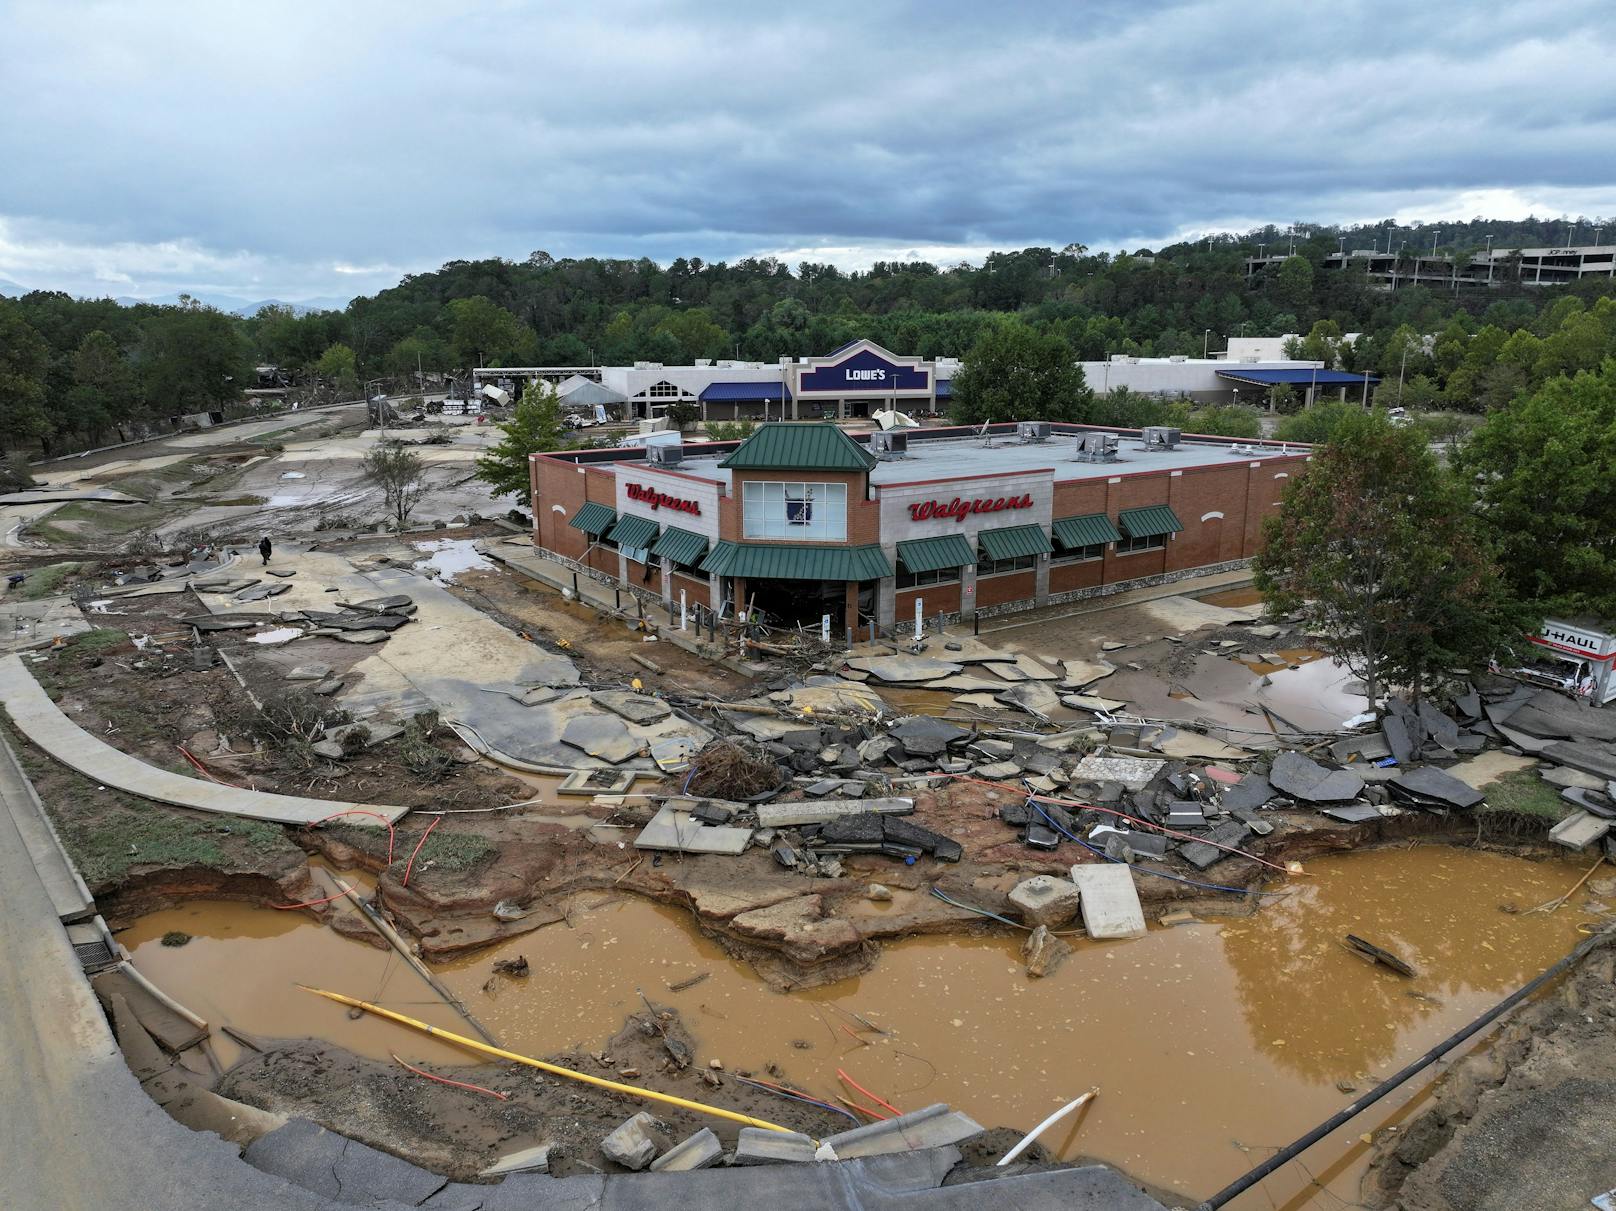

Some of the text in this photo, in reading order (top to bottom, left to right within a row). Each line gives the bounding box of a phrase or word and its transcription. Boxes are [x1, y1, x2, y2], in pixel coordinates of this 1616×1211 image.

[845, 368, 886, 381] LOWE'S
[625, 482, 702, 517] Walgreens
[907, 493, 1034, 523] Walgreens
